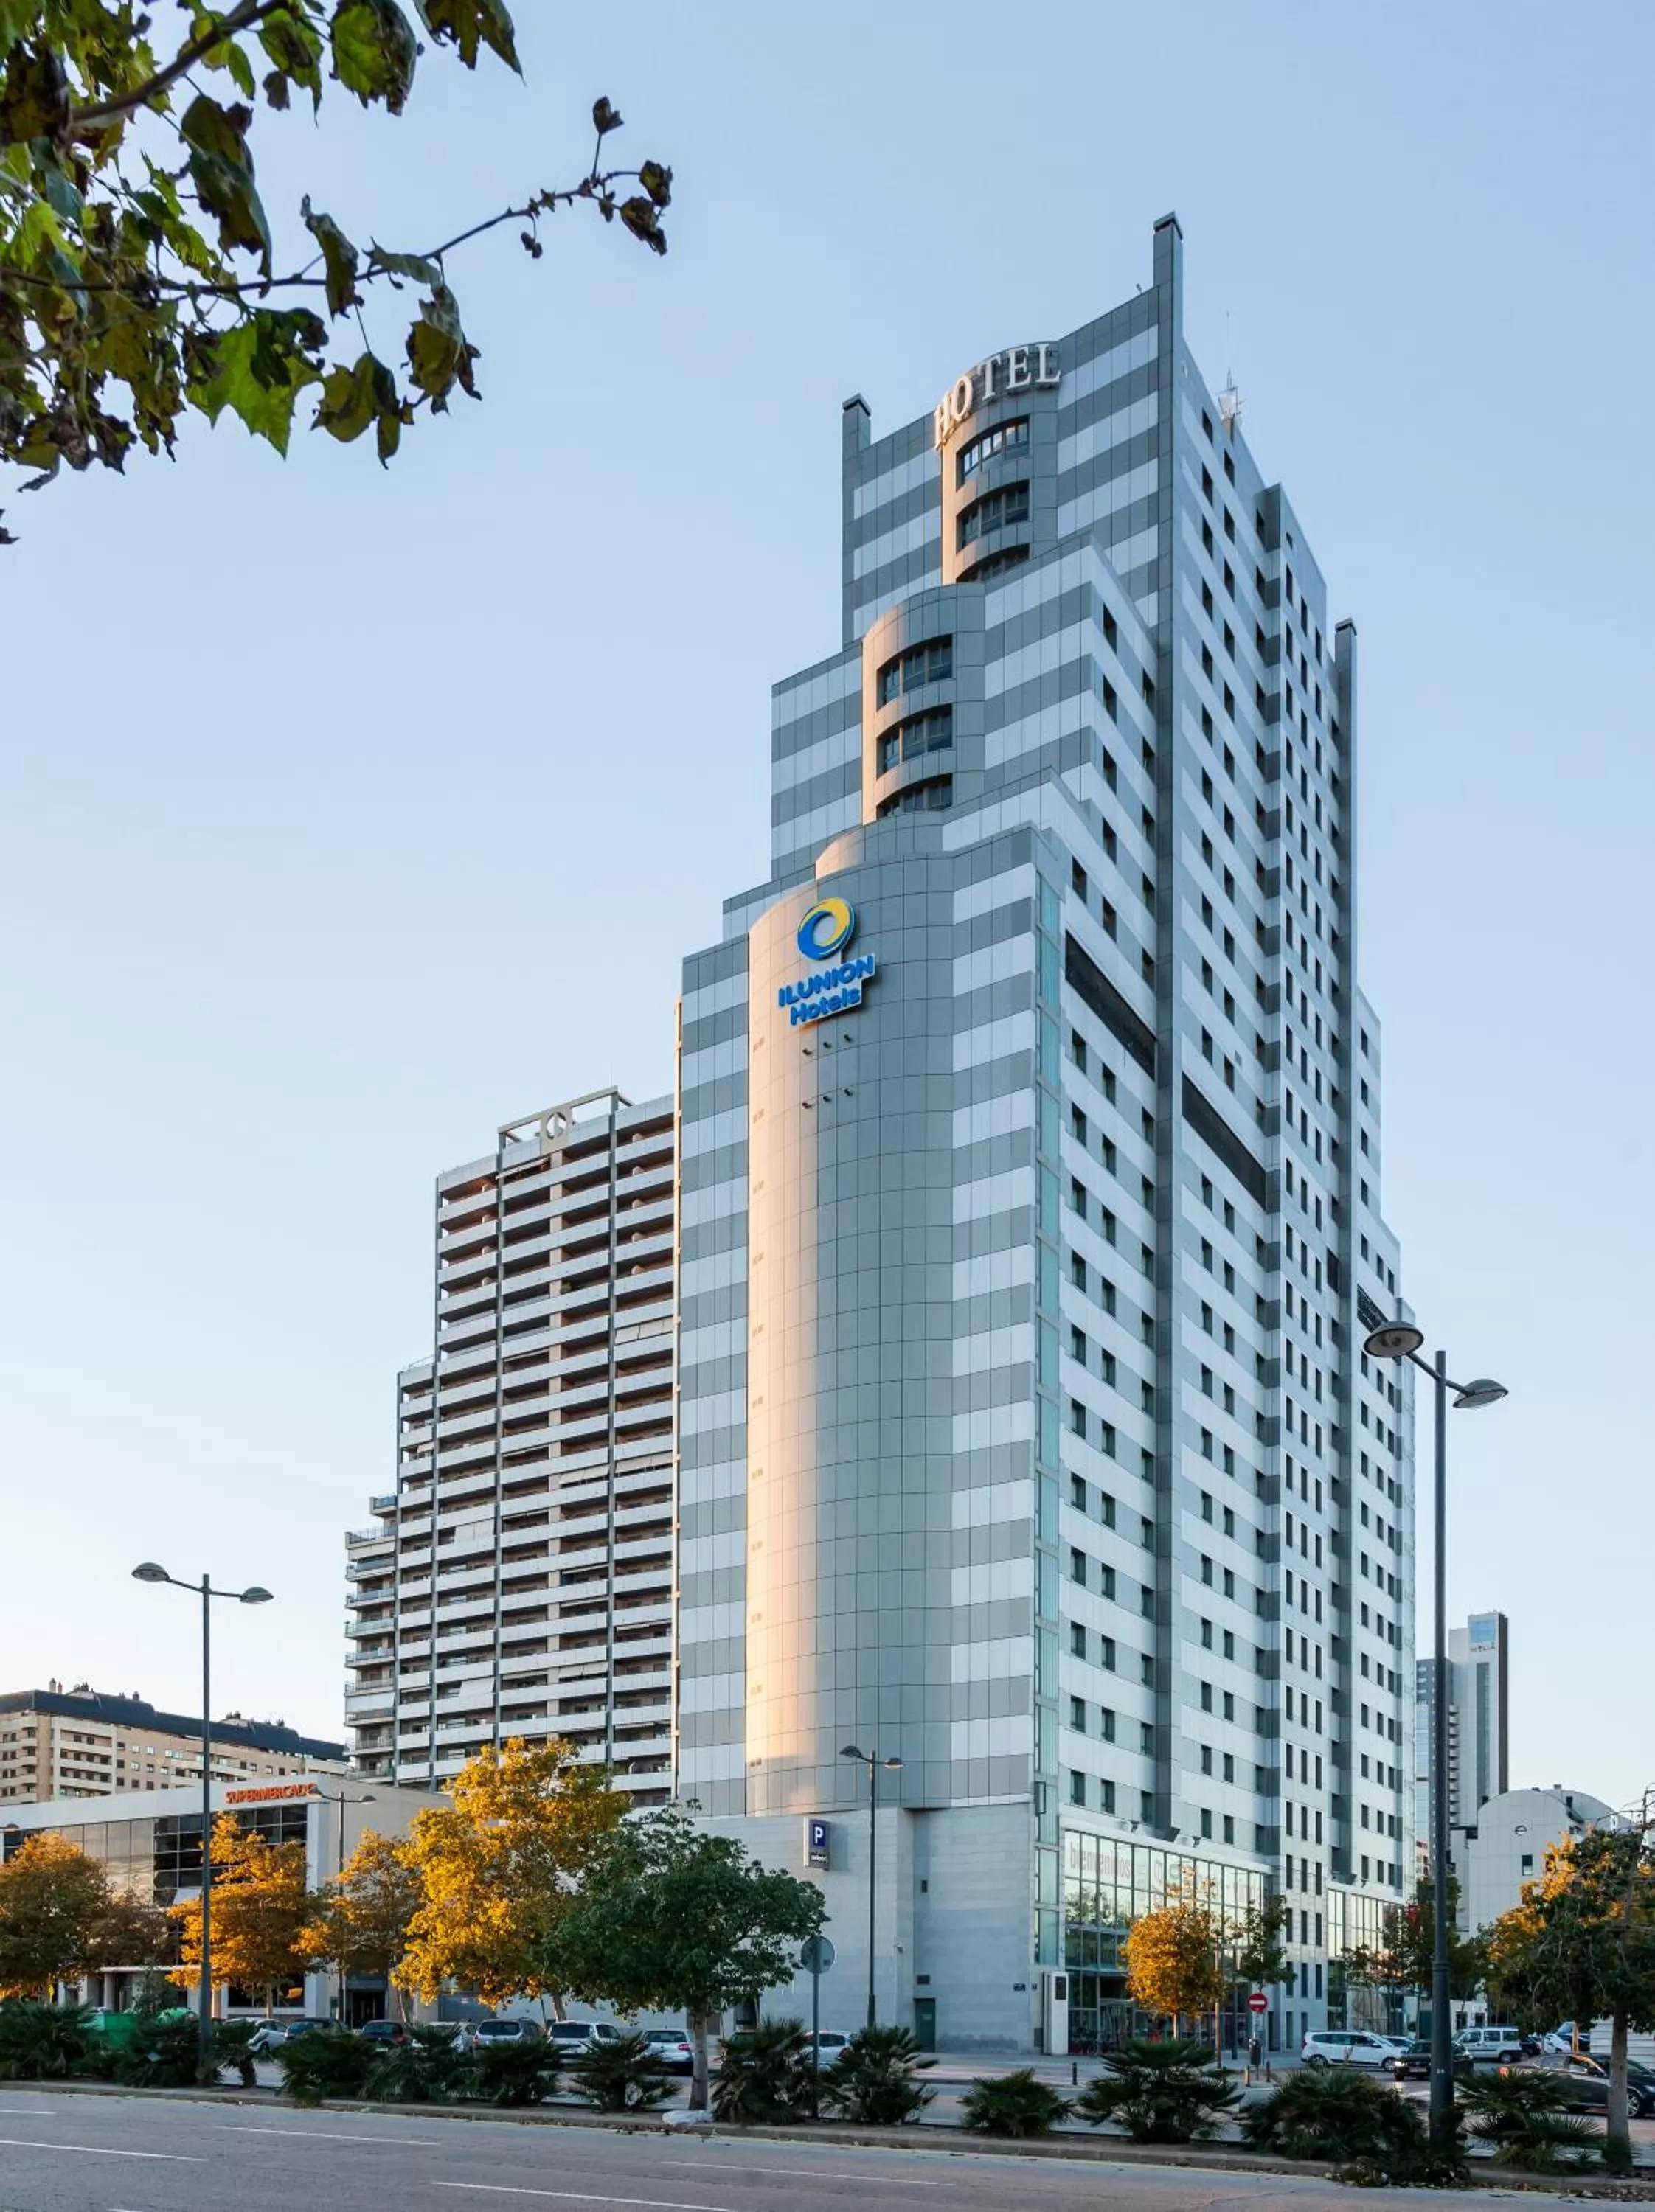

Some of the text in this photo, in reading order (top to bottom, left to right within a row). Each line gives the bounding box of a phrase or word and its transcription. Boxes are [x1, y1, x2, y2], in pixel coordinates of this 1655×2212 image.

[934, 343, 1061, 451] HOTEL
[778, 954, 874, 1007] ILUNION
[790, 987, 861, 1026] Hotels
[814, 1826, 823, 1844] P
